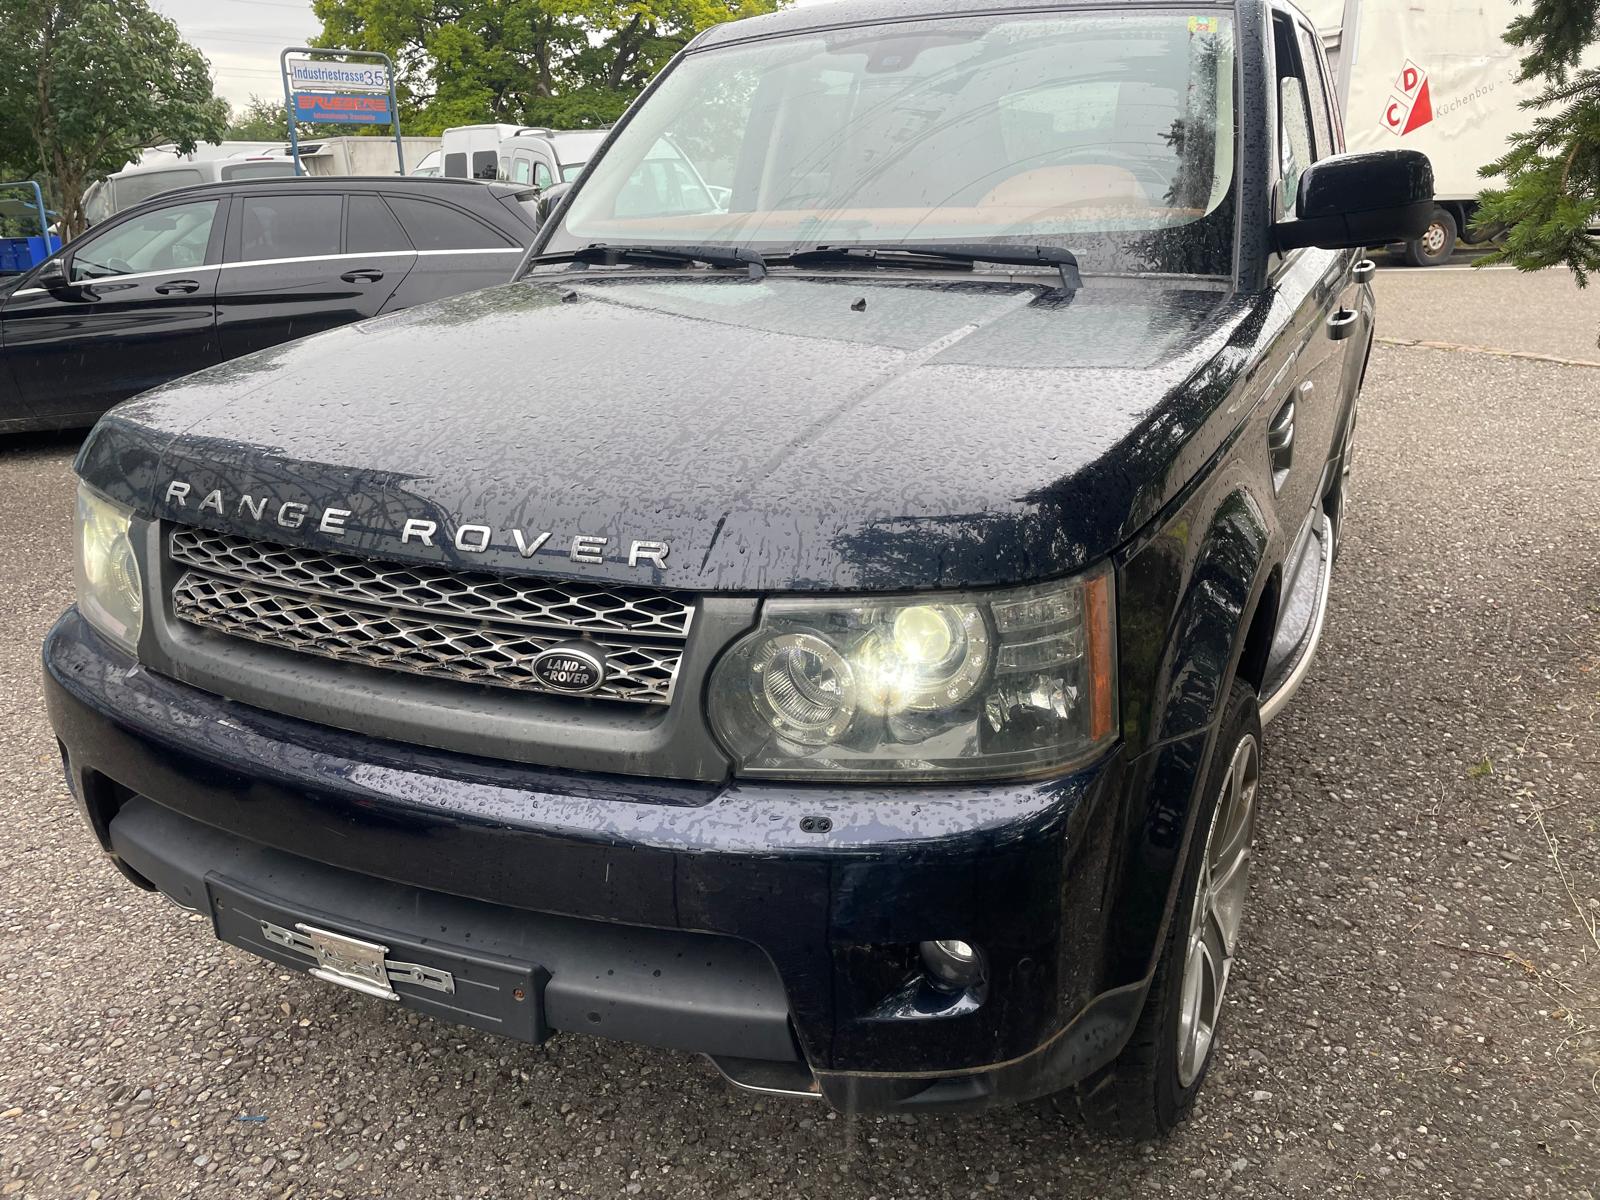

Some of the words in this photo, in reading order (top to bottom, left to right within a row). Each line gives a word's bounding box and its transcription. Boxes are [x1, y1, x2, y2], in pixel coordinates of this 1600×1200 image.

[294, 66, 365, 83] Industriestrasse
[364, 71, 385, 87] 35
[1403, 67, 1418, 92] D
[1436, 82, 1495, 118] Küchenbau
[1386, 103, 1400, 126] C
[165, 480, 352, 535] RANGE
[401, 519, 670, 570] ROVER
[546, 658, 579, 672] LAND
[549, 671, 590, 685] ROVER
